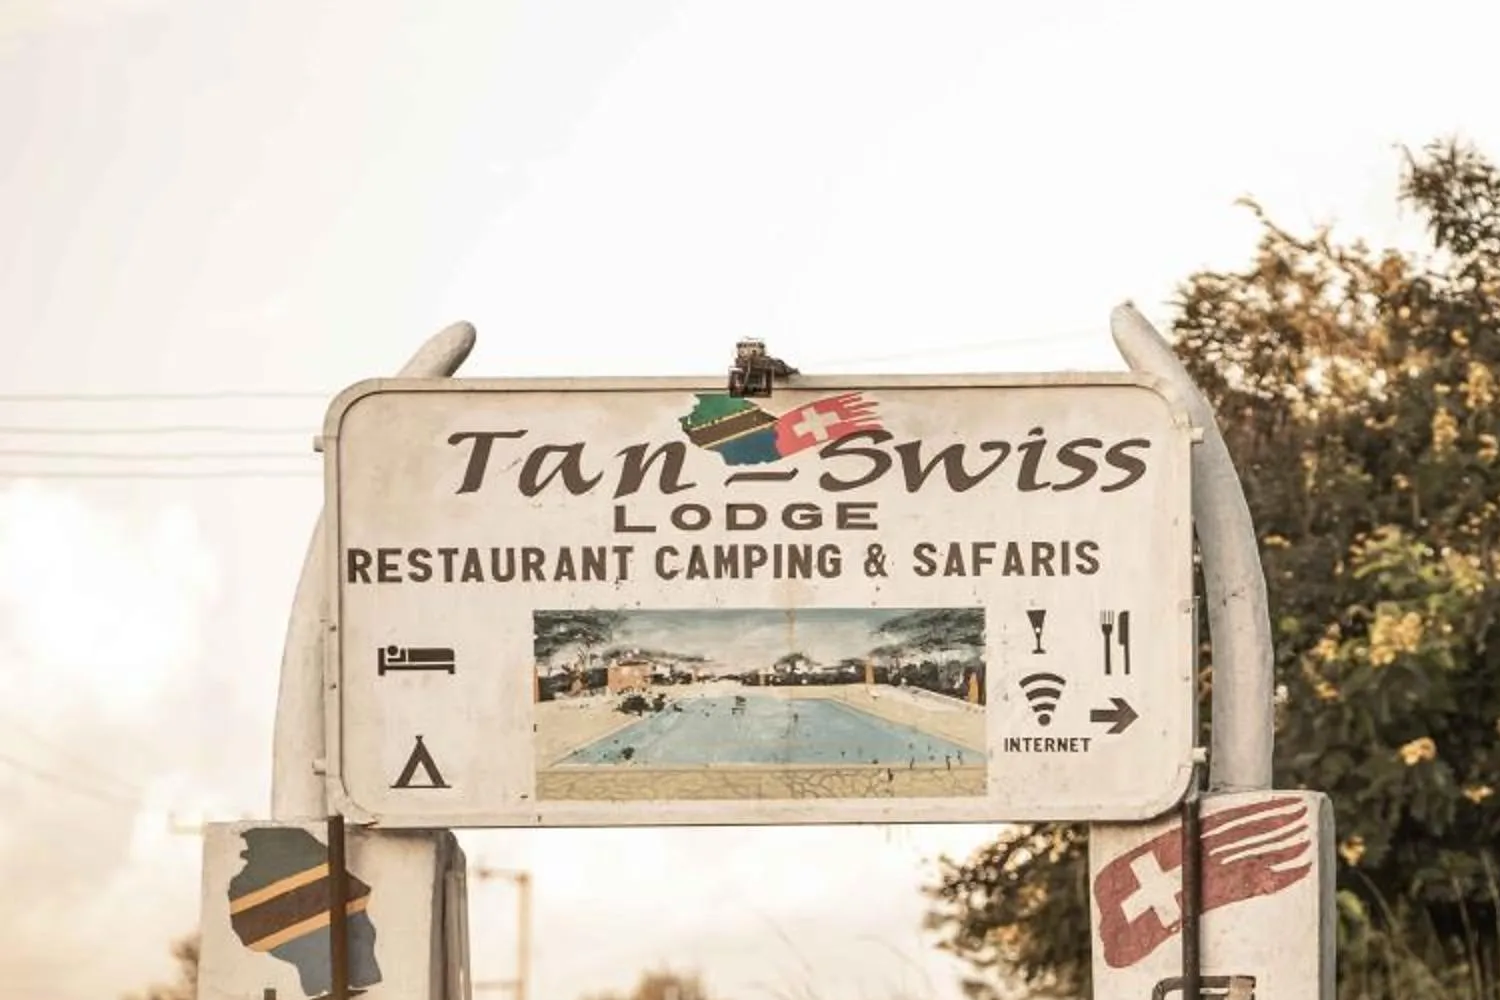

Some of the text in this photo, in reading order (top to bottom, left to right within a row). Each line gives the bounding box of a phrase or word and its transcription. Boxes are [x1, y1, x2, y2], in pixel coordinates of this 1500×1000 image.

[447, 429, 696, 498] Tan
[818, 427, 1151, 493] Swiss
[613, 501, 879, 533] LODGE
[347, 540, 1101, 584] RESTAURANT CAMPING & SAFARIS
[1003, 737, 1092, 753] INTERNET
